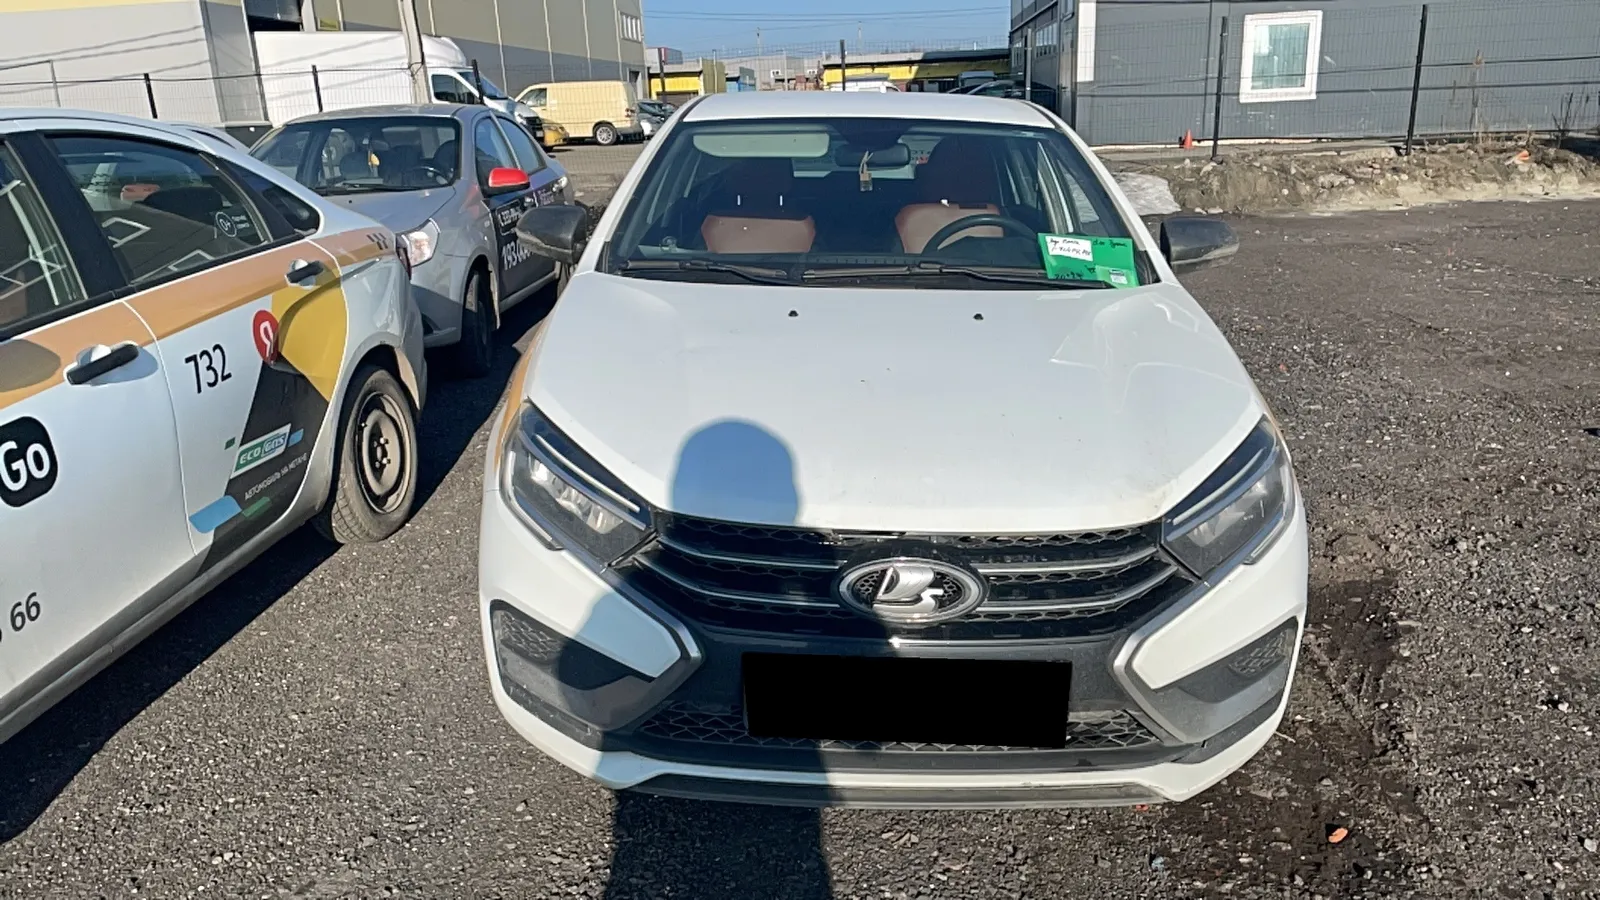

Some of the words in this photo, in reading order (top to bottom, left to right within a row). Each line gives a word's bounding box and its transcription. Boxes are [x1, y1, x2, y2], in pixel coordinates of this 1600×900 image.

[260, 320, 274, 358] Я
[184, 344, 232, 394] 732
[0, 440, 51, 492] Go
[244, 471, 281, 500] АВТОМОБИЛЬ
[10, 592, 41, 632] 66
